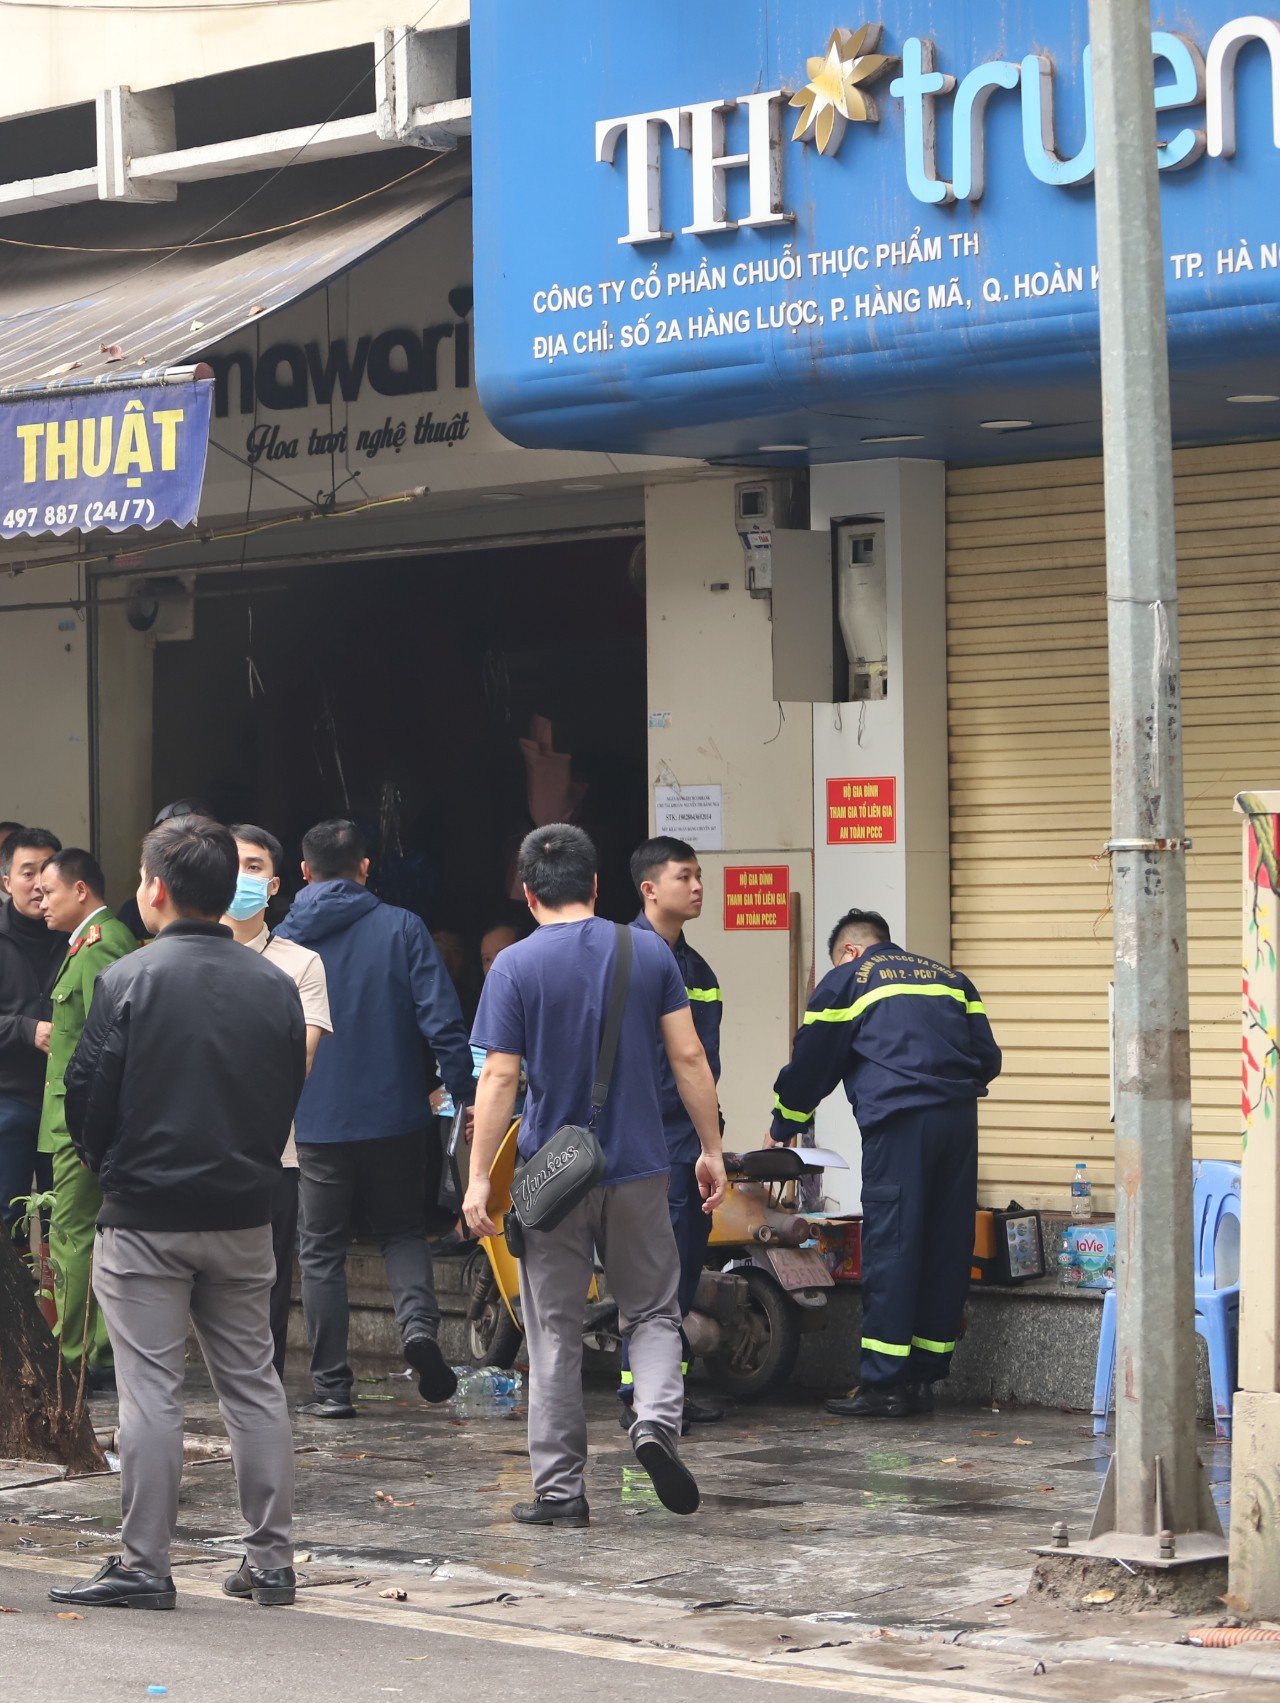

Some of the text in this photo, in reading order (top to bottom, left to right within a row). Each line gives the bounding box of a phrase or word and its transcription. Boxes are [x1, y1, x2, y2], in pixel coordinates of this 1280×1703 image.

[595, 89, 796, 246] TH
[533, 226, 980, 313] CÔNG TY CỔ PHẦN CHUỖI THỰC PHẨM TH
[533, 334, 569, 363] ĐỊA
[573, 320, 615, 354] CHỈ:
[620, 313, 651, 348] SỐ
[655, 319, 683, 343] 2A
[688, 307, 750, 339] HÀNG
[756, 299, 824, 334] LƯỢC,
[831, 298, 848, 322] P.
[855, 284, 921, 318] HÀNG
[928, 276, 972, 311] MÃ,
[982, 278, 1009, 303] Q.
[1014, 261, 1083, 299] HOÀN
[1170, 253, 1204, 280] TP.
[1217, 239, 1254, 274] HÀ
[17, 399, 184, 489] THUẬT
[246, 411, 470, 463] Hoa tươi nghệ thuật
[3, 507, 38, 528] 497
[44, 504, 78, 526] 887
[84, 498, 155, 527] (24/7)
[853, 785, 863, 798] GIA
[830, 806, 846, 819] THAM
[847, 805, 858, 818] GIA
[867, 803, 881, 818] LIÊN
[882, 805, 893, 818] GIA
[840, 824, 883, 839] AN TOÀN PCCC
[748, 873, 758, 886] GIA
[727, 893, 743, 906] THAM
[744, 893, 754, 906] GIA
[762, 891, 776, 906] LIÊN
[776, 893, 787, 905] GIA
[736, 910, 777, 926] AN TOÀN PCCC
[888, 955, 915, 963] PCCC
[879, 967, 898, 980] ĐỘI
[900, 969, 906, 979] 2
[515, 1145, 580, 1213] Yankees
